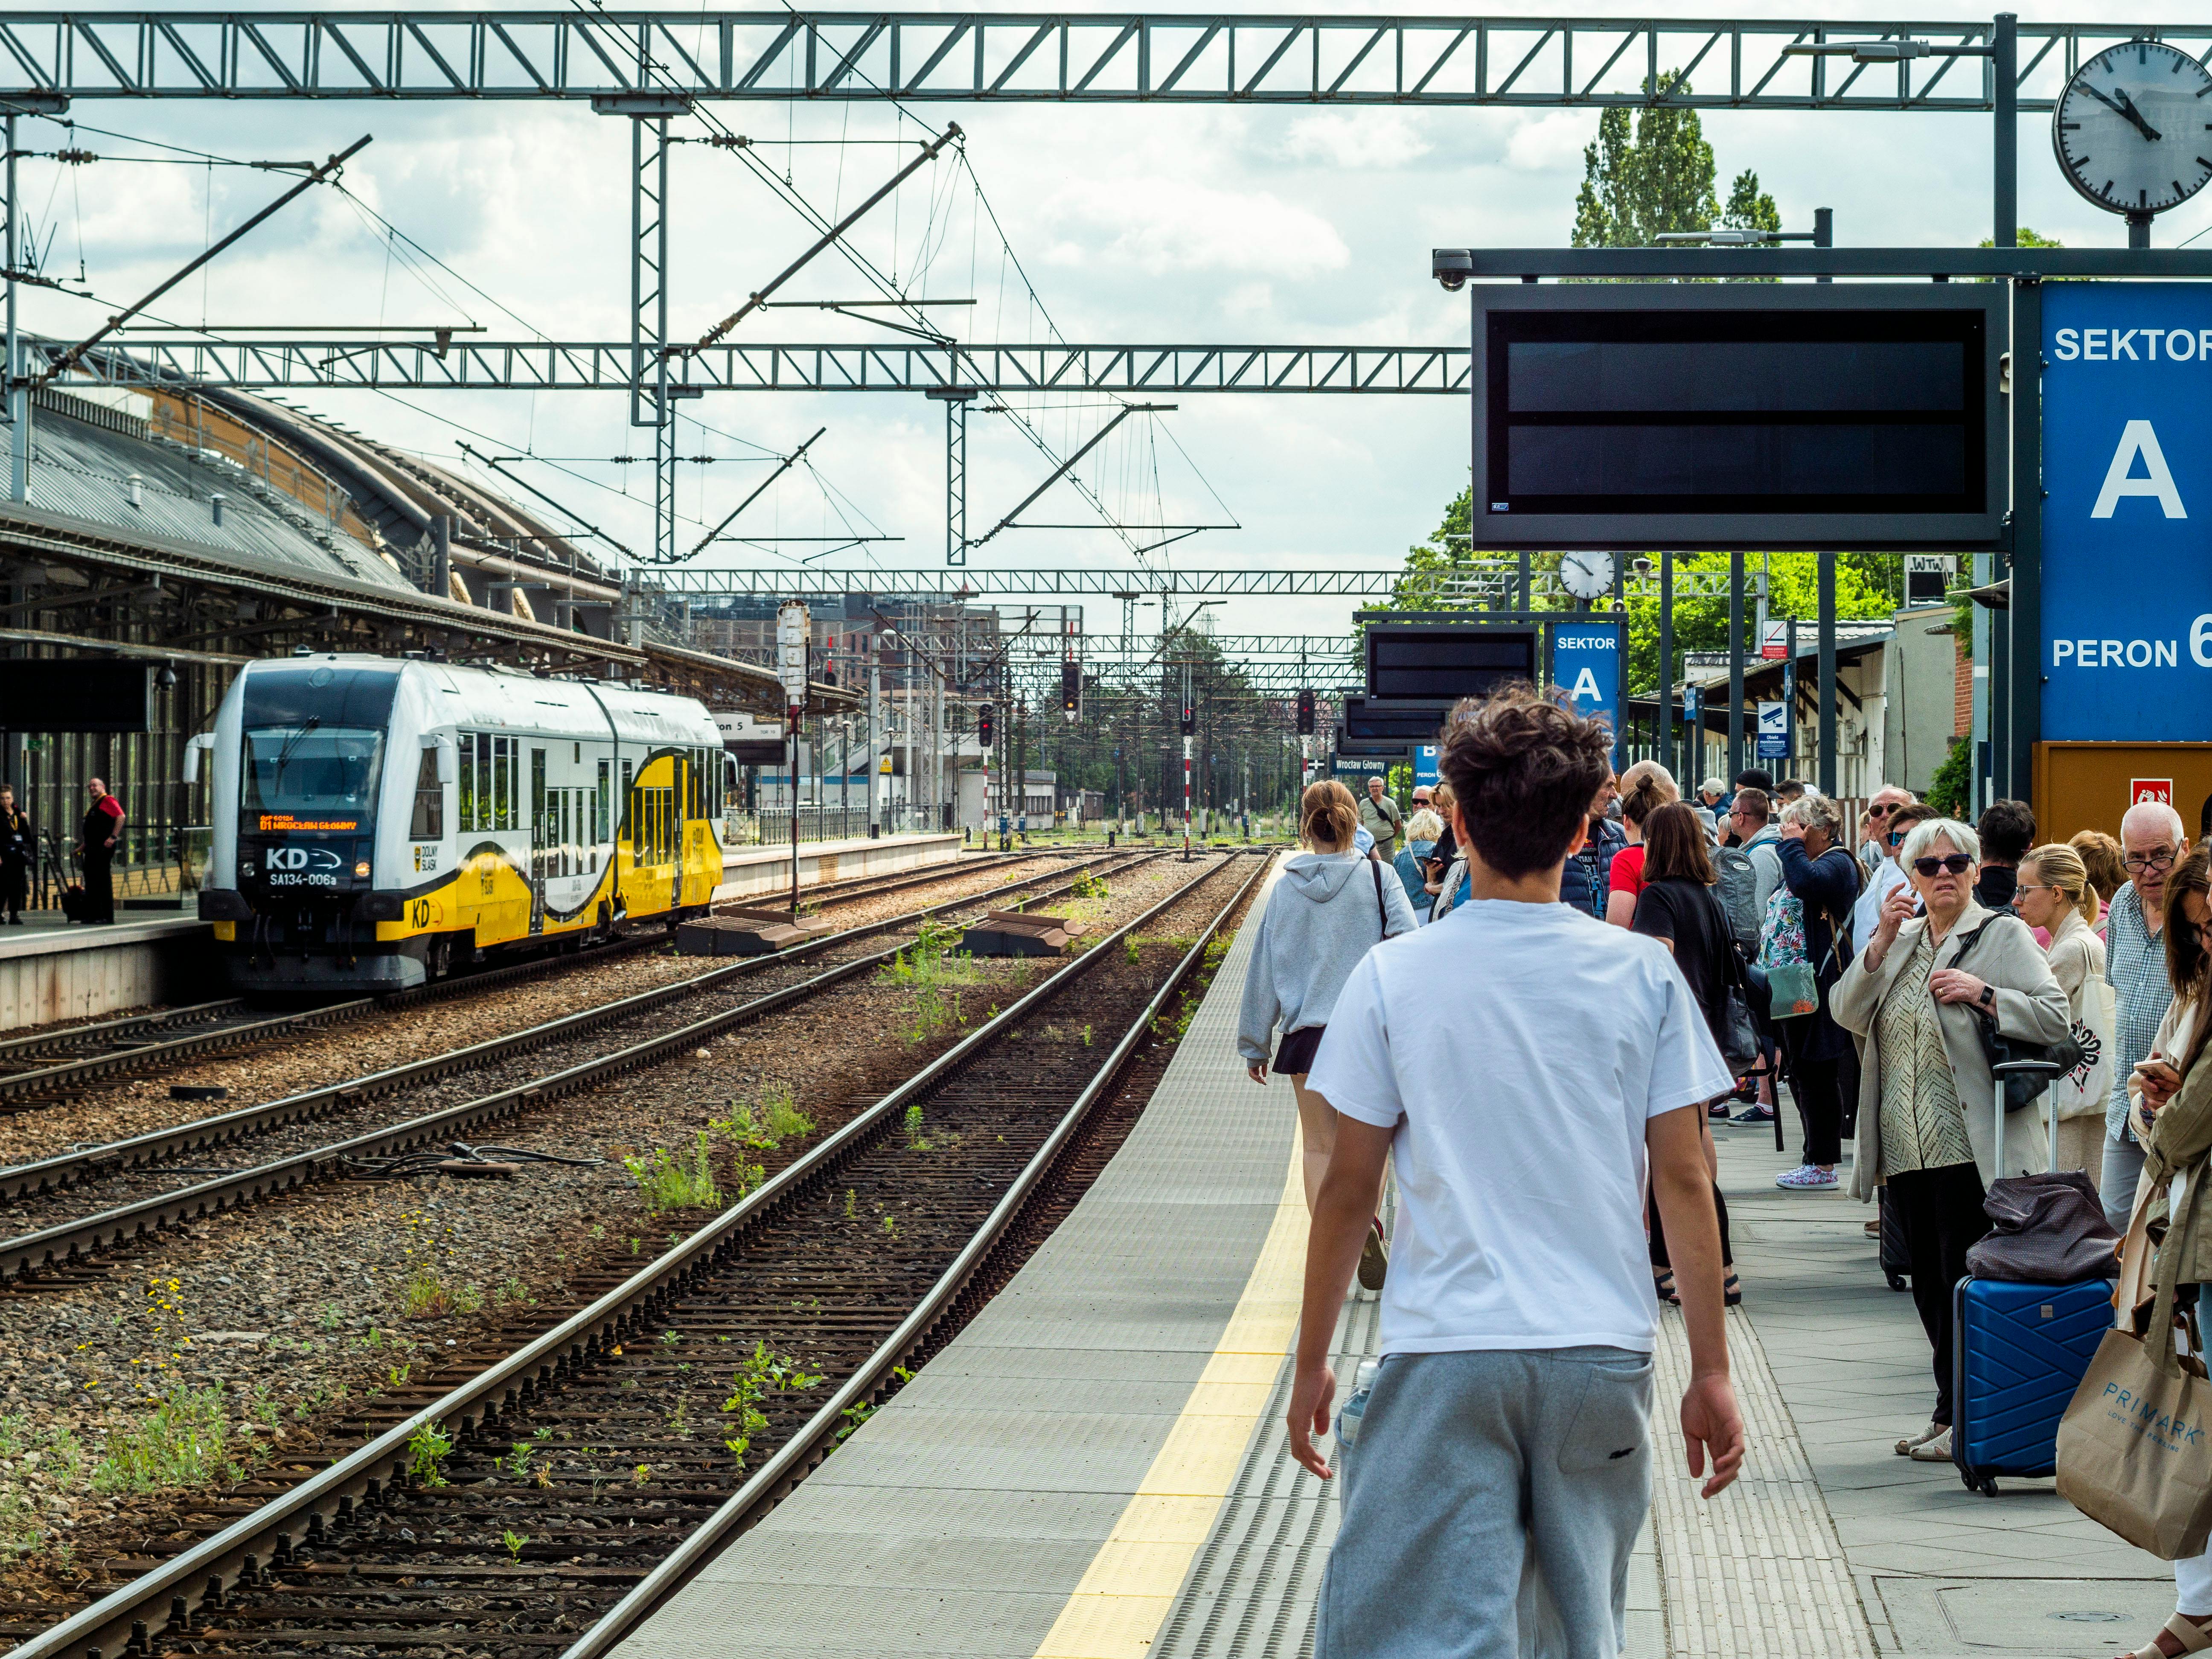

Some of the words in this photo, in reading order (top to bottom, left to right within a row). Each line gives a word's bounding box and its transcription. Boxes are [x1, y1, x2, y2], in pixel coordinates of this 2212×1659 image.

[2090, 420, 2188, 518] A
[1557, 637, 1616, 649] SEKTOR
[2053, 640, 2177, 668] PERON
[2189, 613, 2212, 668] 6
[1571, 667, 1603, 701] A
[737, 722, 743, 731] 5
[1423, 745, 1437, 757] B
[1336, 760, 1361, 769] Wrocław
[1362, 760, 1385, 772] Główny
[260, 820, 272, 830] D1
[273, 821, 318, 830] WROCŁAW
[266, 848, 308, 870] KD
[270, 873, 337, 886] SA134-006a
[412, 899, 430, 928] KD
[2103, 1382, 2200, 1445] PRIMARK
[2107, 1410, 2127, 1424] LOVE
[2130, 1422, 2144, 1434] THE
[2147, 1432, 2180, 1453] FEELING
